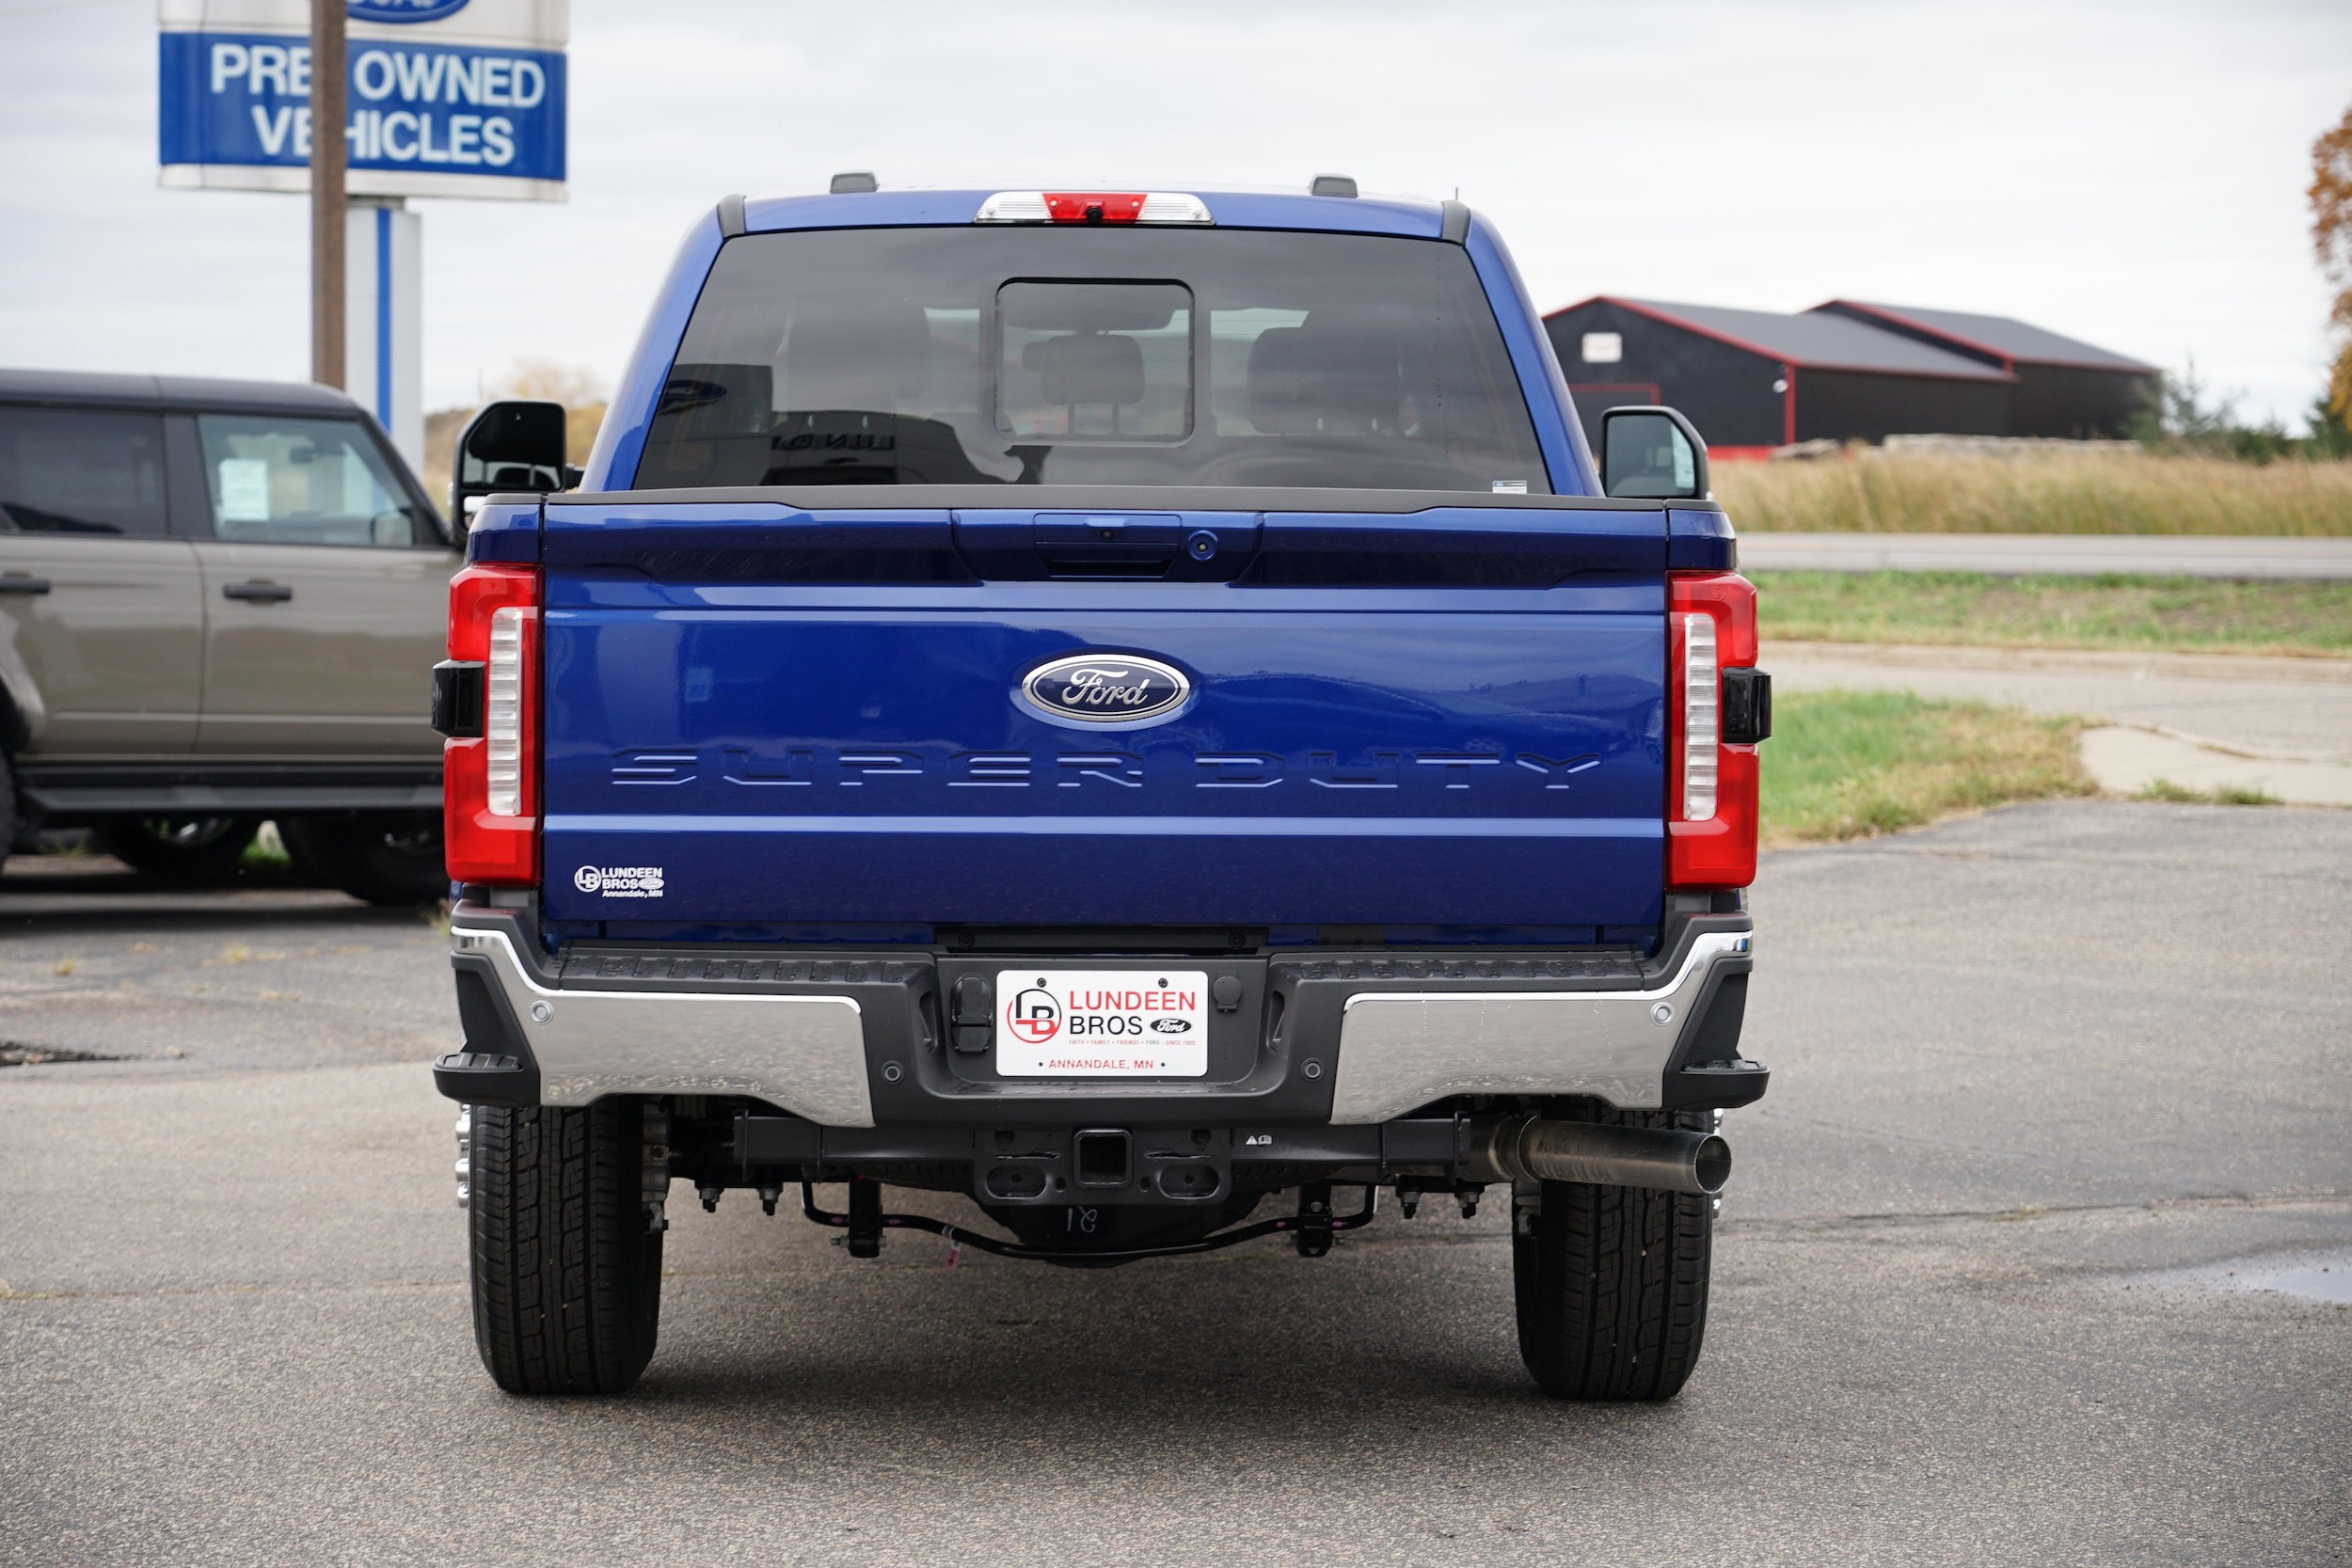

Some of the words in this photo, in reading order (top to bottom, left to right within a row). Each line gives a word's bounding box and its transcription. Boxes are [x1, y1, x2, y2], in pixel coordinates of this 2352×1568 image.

[210, 42, 312, 96] PRE
[353, 50, 547, 108] OWNED
[1061, 668, 1151, 705] Ford
[612, 750, 1144, 786] SUPER
[1195, 752, 1601, 789] DUTY
[601, 867, 663, 879] LUNDEEN
[601, 878, 639, 890] BROS
[648, 889, 664, 898] MN
[1069, 990, 1197, 1011] LUNDEEN
[1069, 1015, 1144, 1036] BROS
[1155, 1019, 1187, 1033] Ford
[1048, 1059, 1130, 1070] ANNANDALE,
[1134, 1059, 1154, 1069] MN
